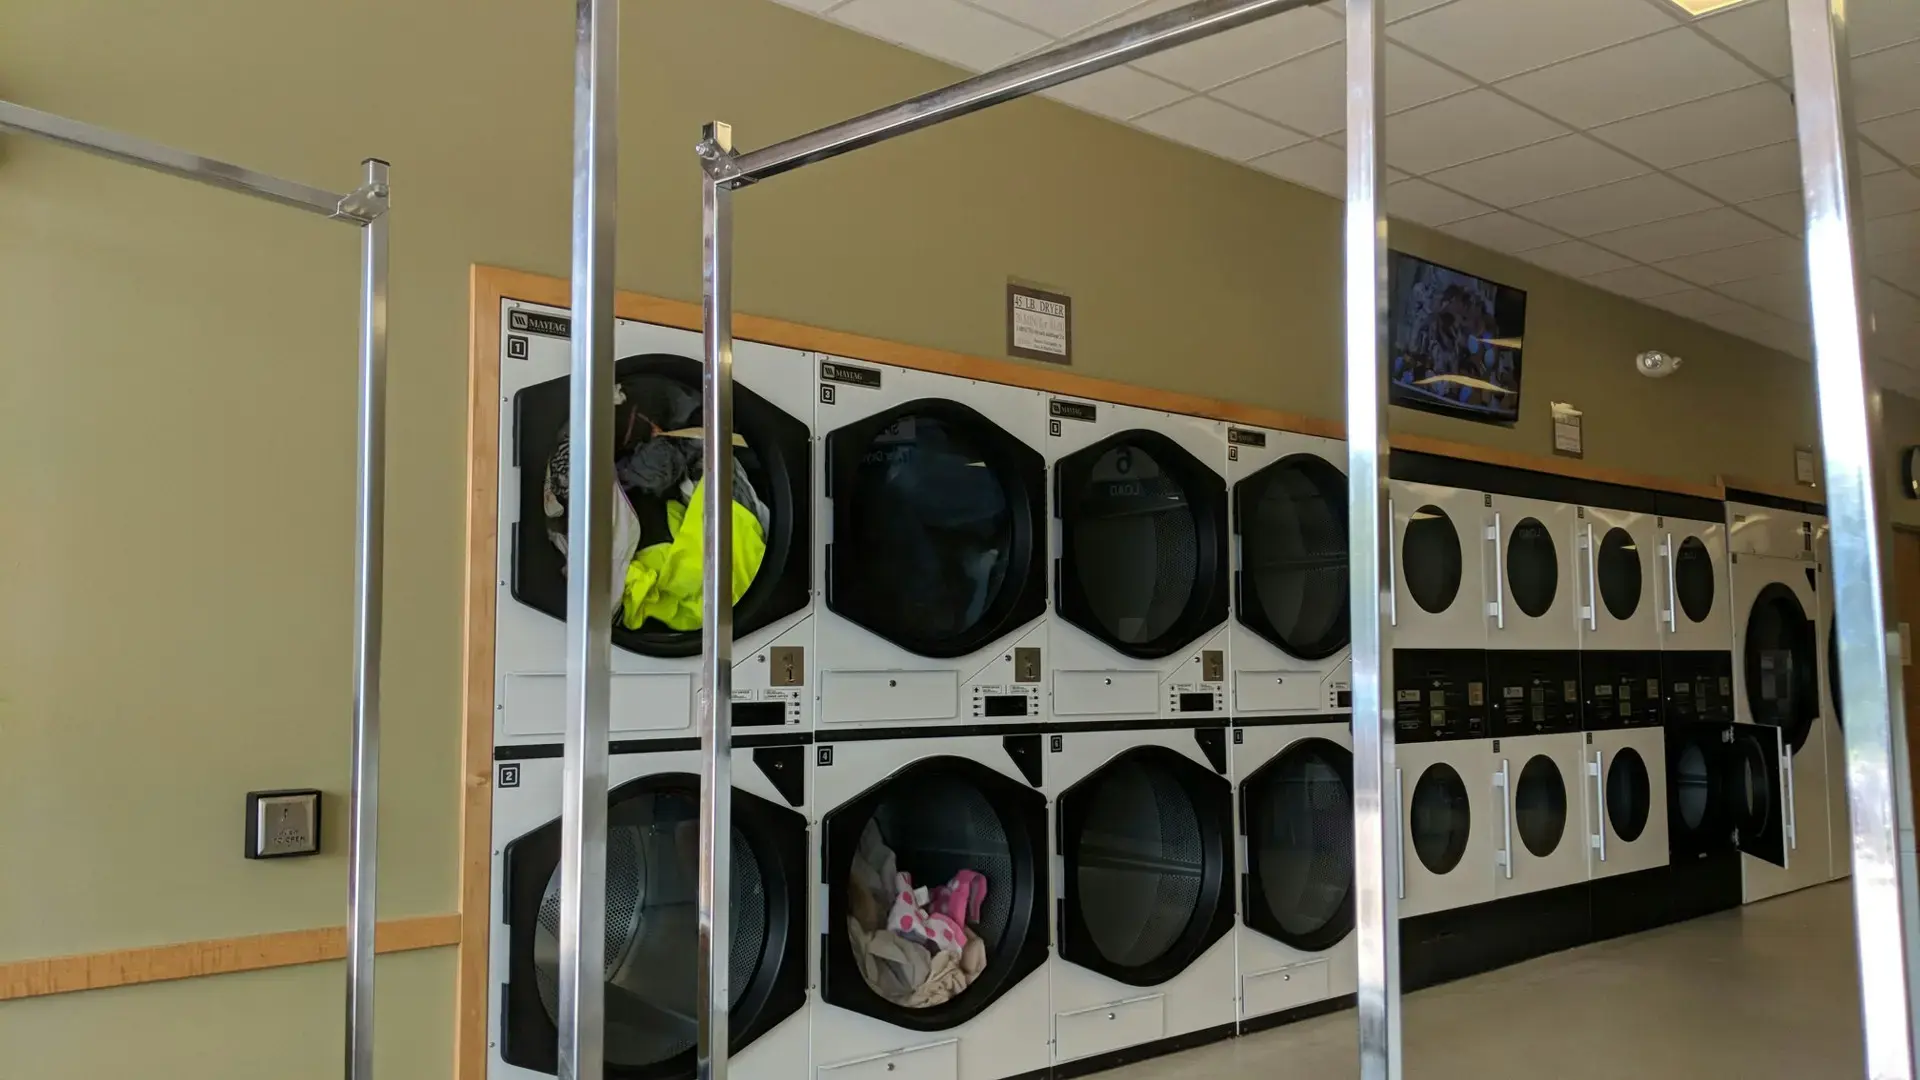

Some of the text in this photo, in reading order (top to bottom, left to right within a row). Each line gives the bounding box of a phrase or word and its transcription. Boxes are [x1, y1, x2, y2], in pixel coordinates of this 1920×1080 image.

[1015, 295, 1064, 316] 45 LB DRYER
[529, 318, 566, 332] MAYTAG
[835, 369, 863, 380] MAYTAG
[505, 771, 513, 781] 2
